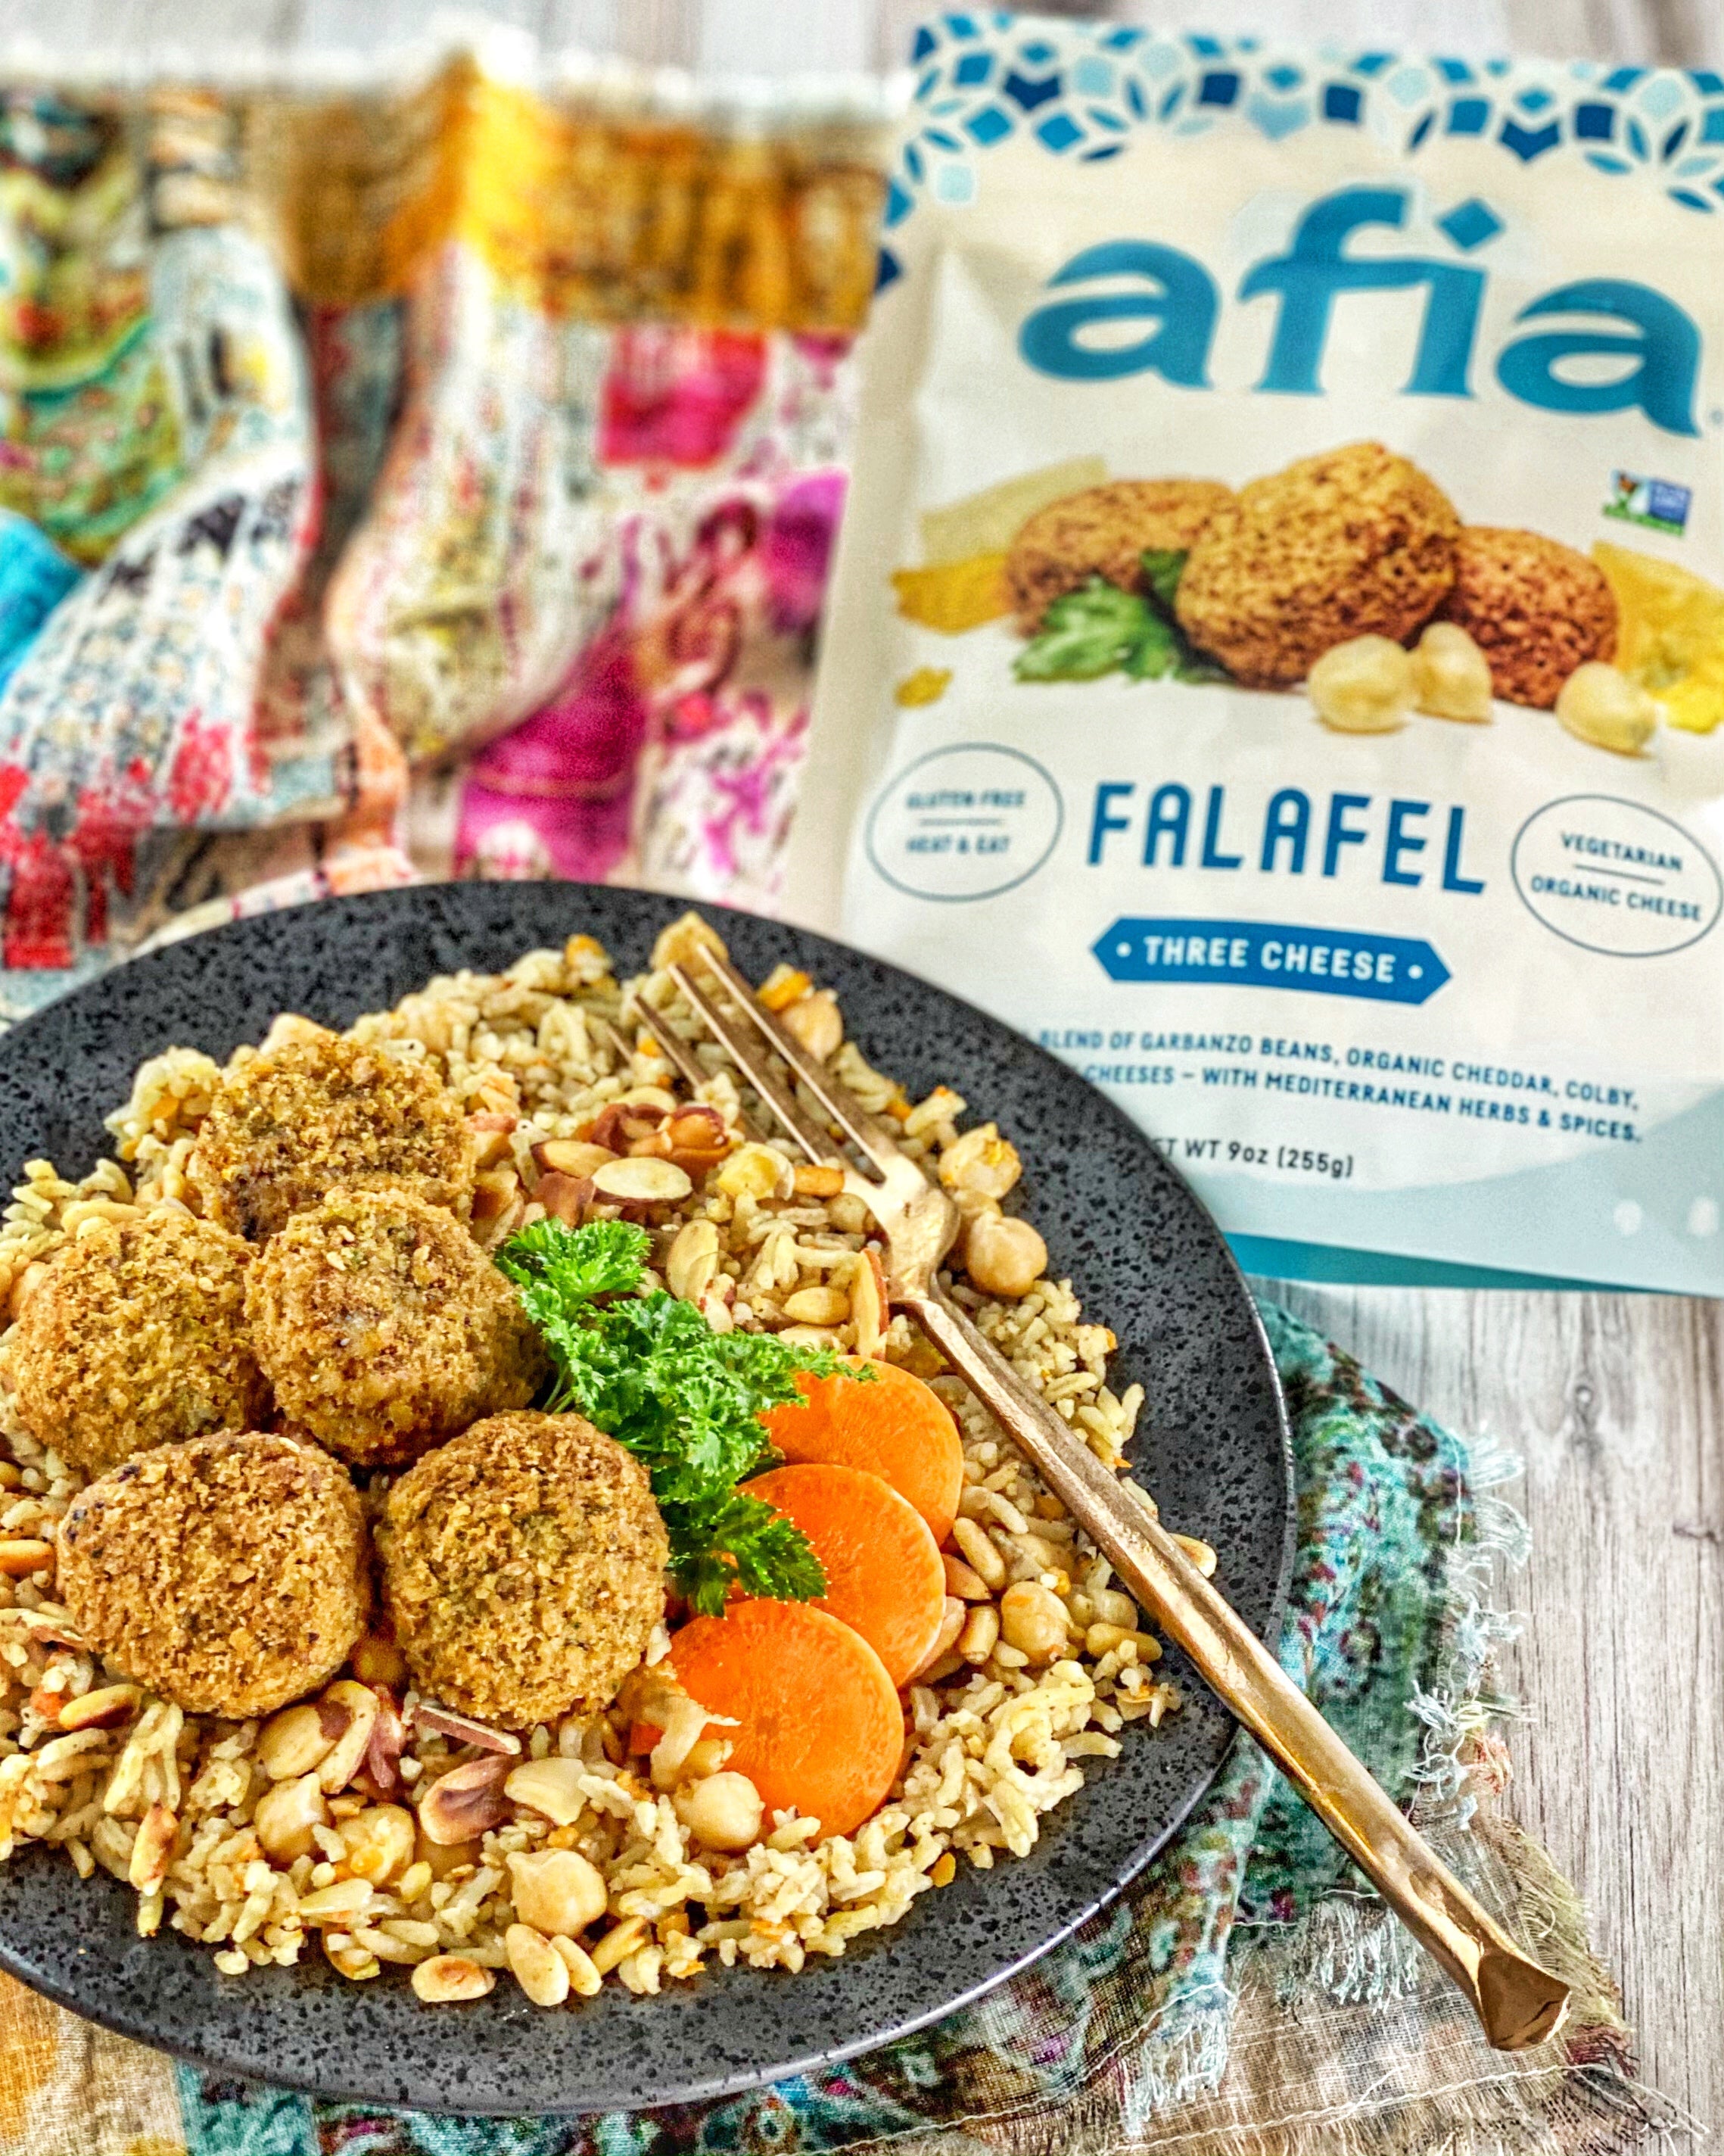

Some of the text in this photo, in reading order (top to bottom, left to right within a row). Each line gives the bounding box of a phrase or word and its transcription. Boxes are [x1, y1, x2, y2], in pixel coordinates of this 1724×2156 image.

[1019, 183, 1703, 438] afia
[906, 790, 1026, 809] GLUTEN FREE
[906, 836, 953, 854] HEAT
[975, 837, 1010, 855] EAT
[1087, 781, 1486, 895] FALAFEL
[1561, 832, 1682, 871] VEGETARIAN
[1531, 875, 1702, 922] ORGANIC CHEESE
[1144, 936, 1396, 983] THREE CHEESE
[1040, 1030, 1639, 1111] BLEND OF GARBANZO BEANS, ORGANIC CHEDDAR, COLBY,
[1083, 1064, 1174, 1084] CHEESES
[1202, 1067, 1257, 1088] WITH
[1265, 1073, 1451, 1114] MEDITERRANEAN
[1458, 1098, 1530, 1125] HERBS
[1537, 1109, 1551, 1128] &
[1559, 1113, 1642, 1143] SPICES.
[1184, 1139, 1221, 1160] WT
[1228, 1142, 1268, 1165] 9oz
